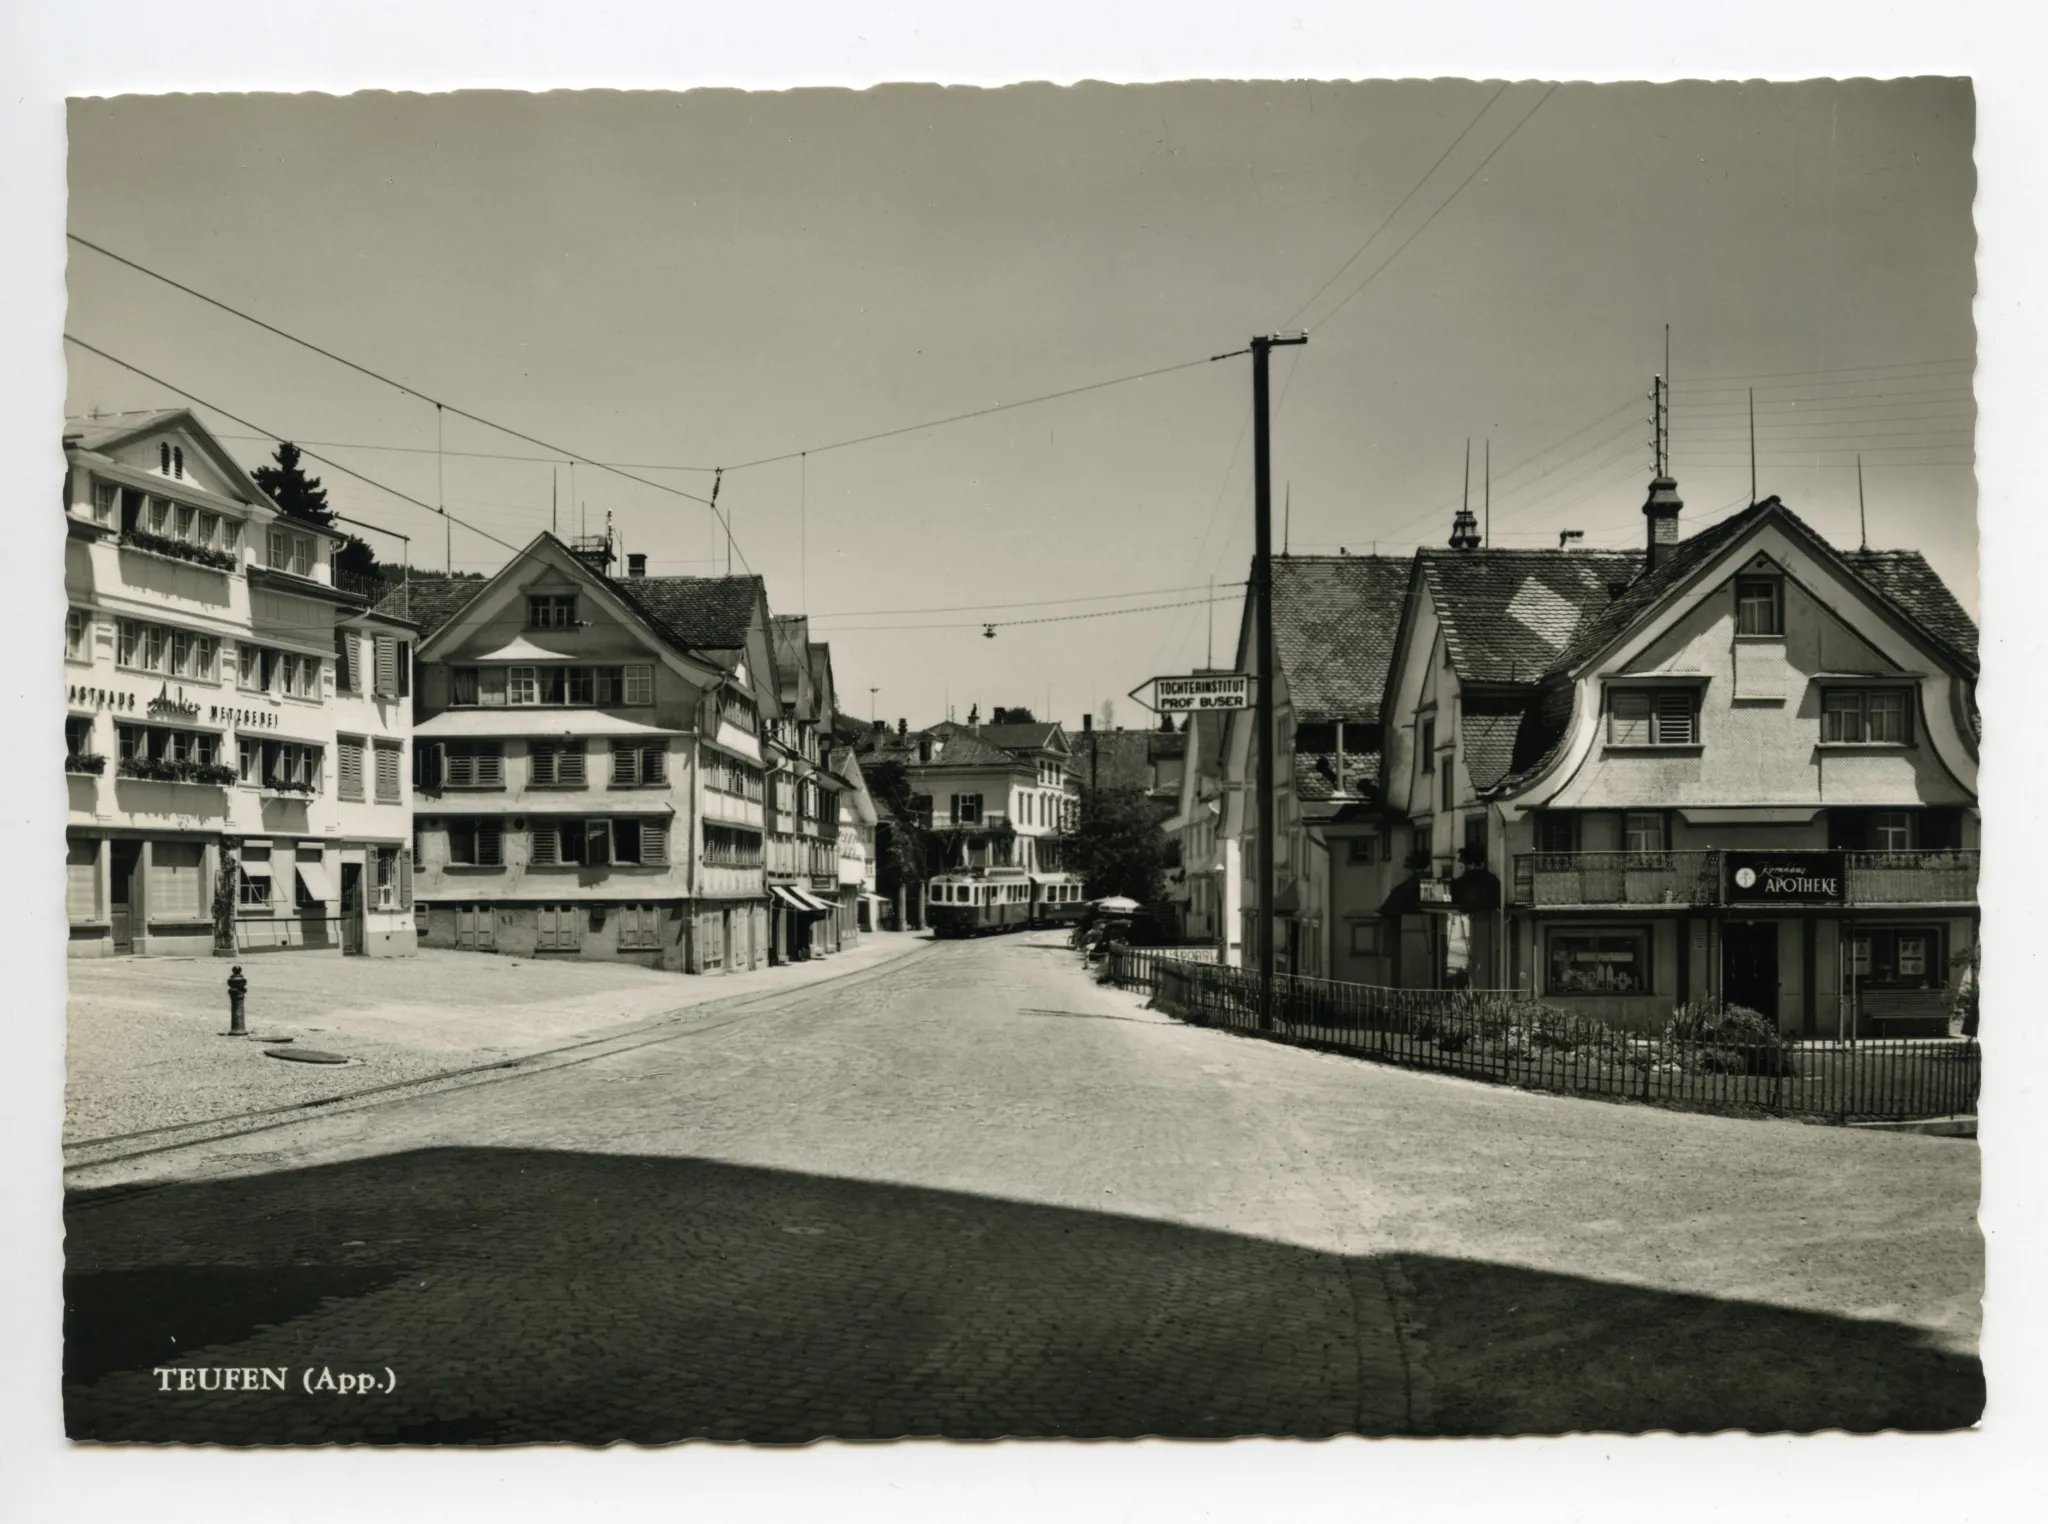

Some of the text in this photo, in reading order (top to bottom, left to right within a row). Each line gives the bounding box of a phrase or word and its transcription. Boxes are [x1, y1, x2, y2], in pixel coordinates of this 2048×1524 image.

[1160, 680, 1245, 695] TOCHTERINSTITUT
[65, 684, 135, 707] ASTHAUS
[211, 705, 278, 726] METZGEREI
[1161, 696, 1244, 708] PROF BUSER
[1764, 877, 1839, 896] APOTHEKE
